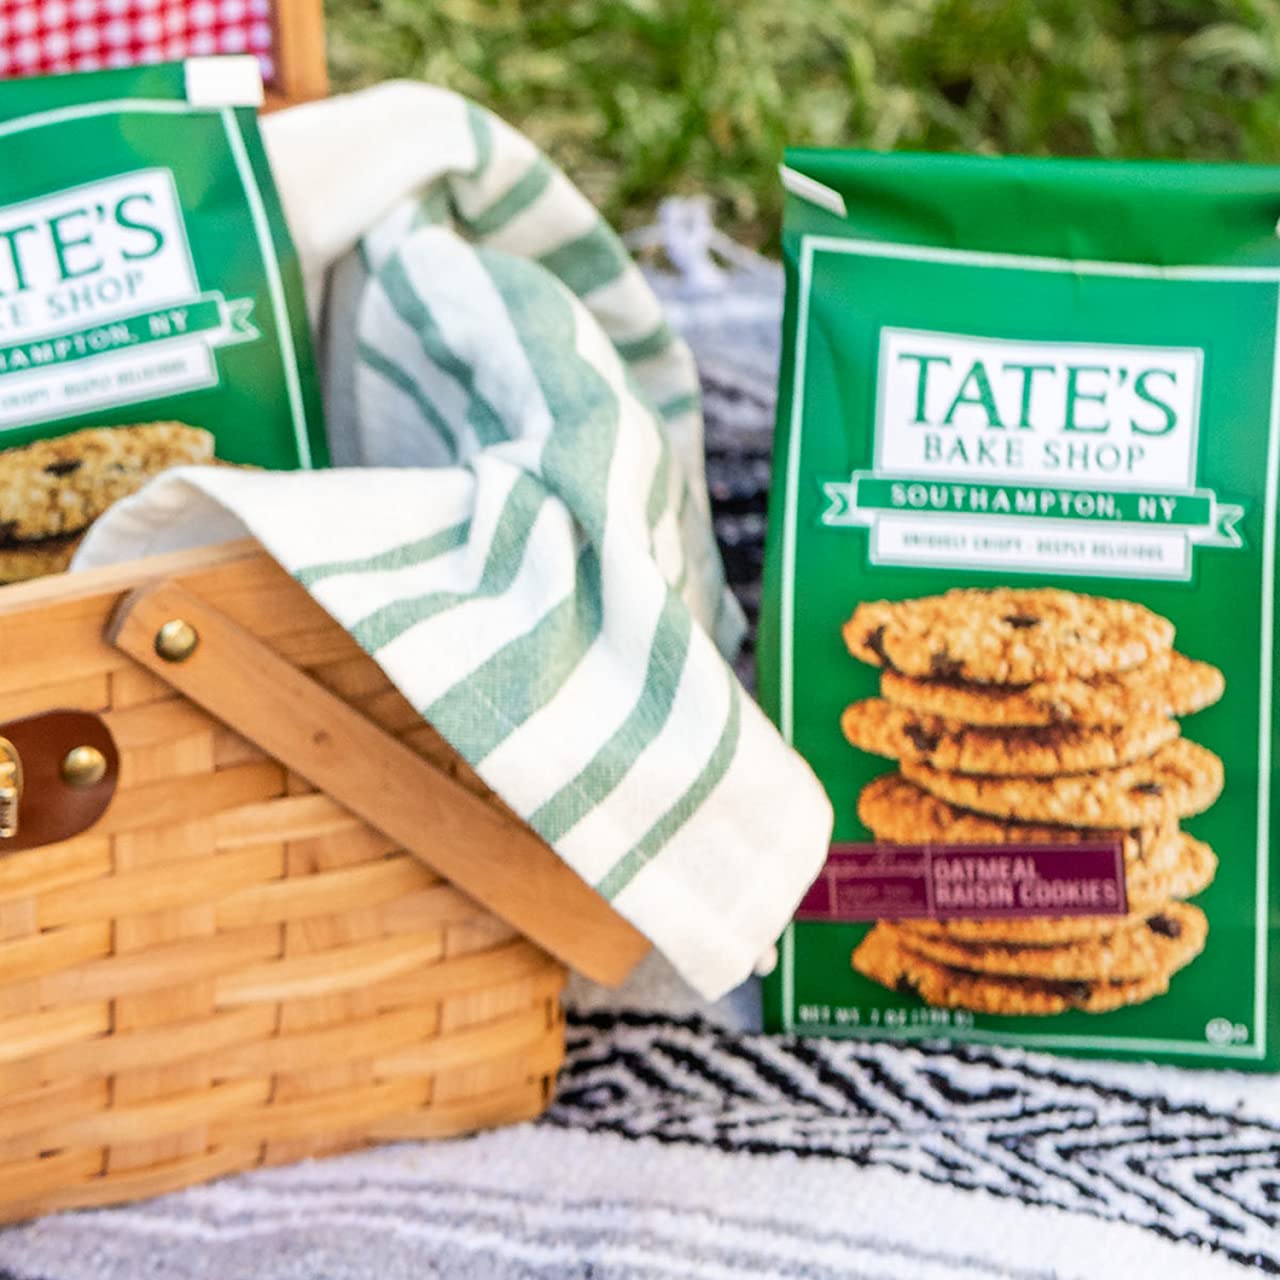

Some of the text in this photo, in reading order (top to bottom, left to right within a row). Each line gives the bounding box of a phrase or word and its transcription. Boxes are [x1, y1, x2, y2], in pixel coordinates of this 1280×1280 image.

[47, 271, 145, 321] SHOP
[149, 309, 190, 337] NY
[897, 352, 1178, 438] TATE'S
[922, 432, 1146, 474] BAKE SHOP
[1137, 495, 1178, 521] NY
[933, 857, 1038, 882] OATMEAL
[934, 879, 1014, 907] RAISIN
[1020, 878, 1118, 909] COOKIES
